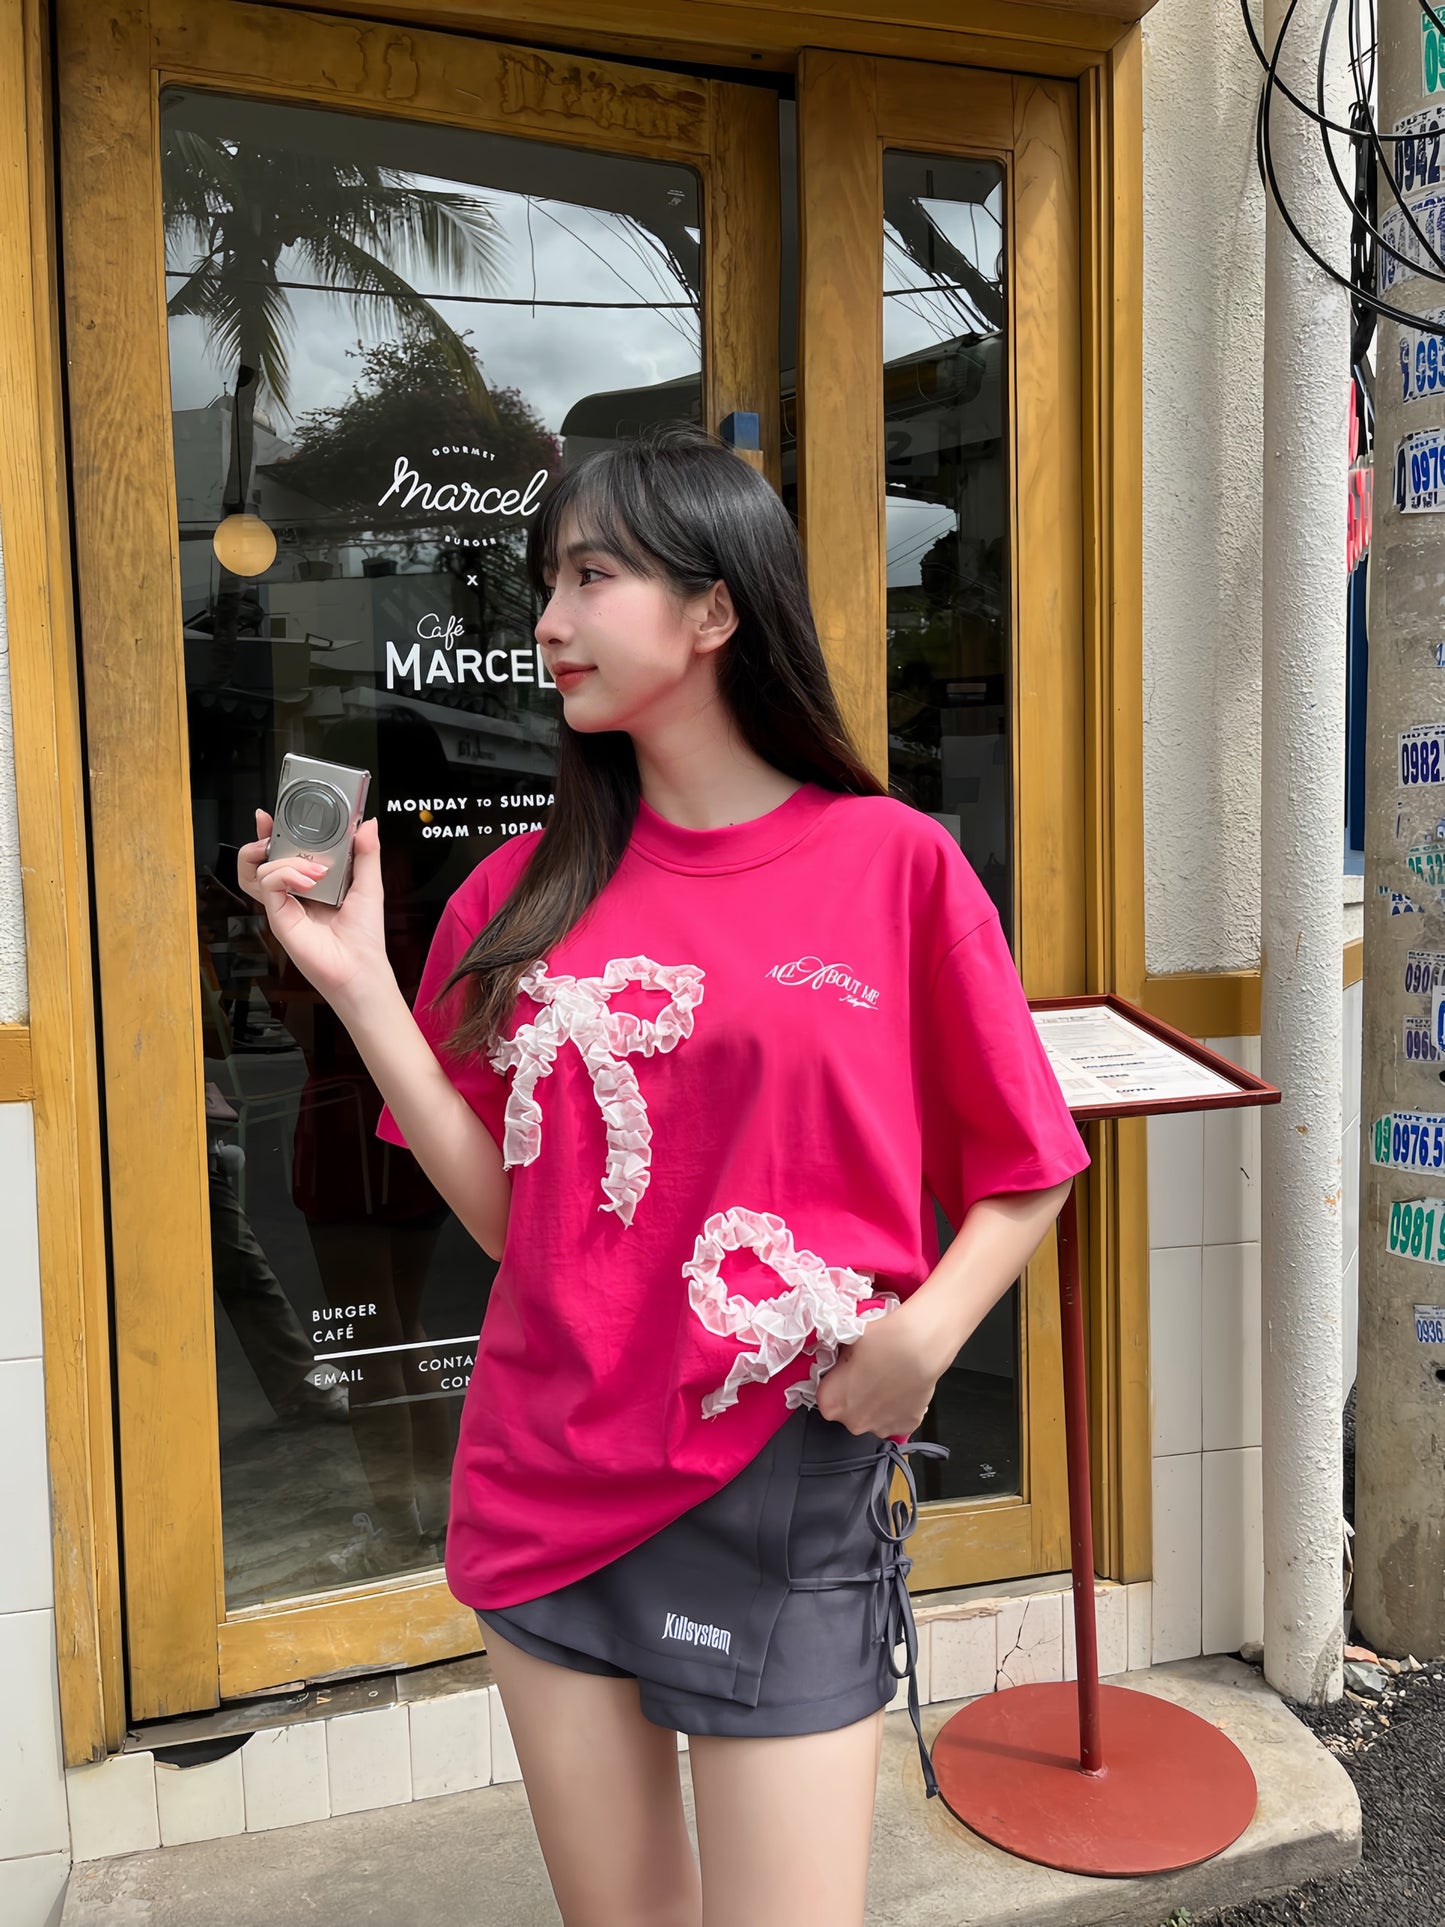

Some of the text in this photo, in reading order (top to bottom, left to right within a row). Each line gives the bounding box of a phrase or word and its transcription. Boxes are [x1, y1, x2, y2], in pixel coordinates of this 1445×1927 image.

[432, 445, 496, 462] GOURMET
[378, 456, 549, 516] Marcel
[444, 535, 497, 547] BURGER
[417, 613, 465, 651] Café
[385, 641, 557, 691] MARCEL
[386, 797, 468, 812] MONDAY
[421, 825, 470, 839] 09AM
[501, 822, 543, 836] 10PM
[861, 985, 880, 1005] ME
[312, 1303, 377, 1322] BURGER
[312, 1323, 354, 1343] CAFÉ
[418, 1355, 477, 1372] CONTA
[314, 1368, 364, 1386] EMAIL
[661, 1612, 732, 1656] Killsystem
